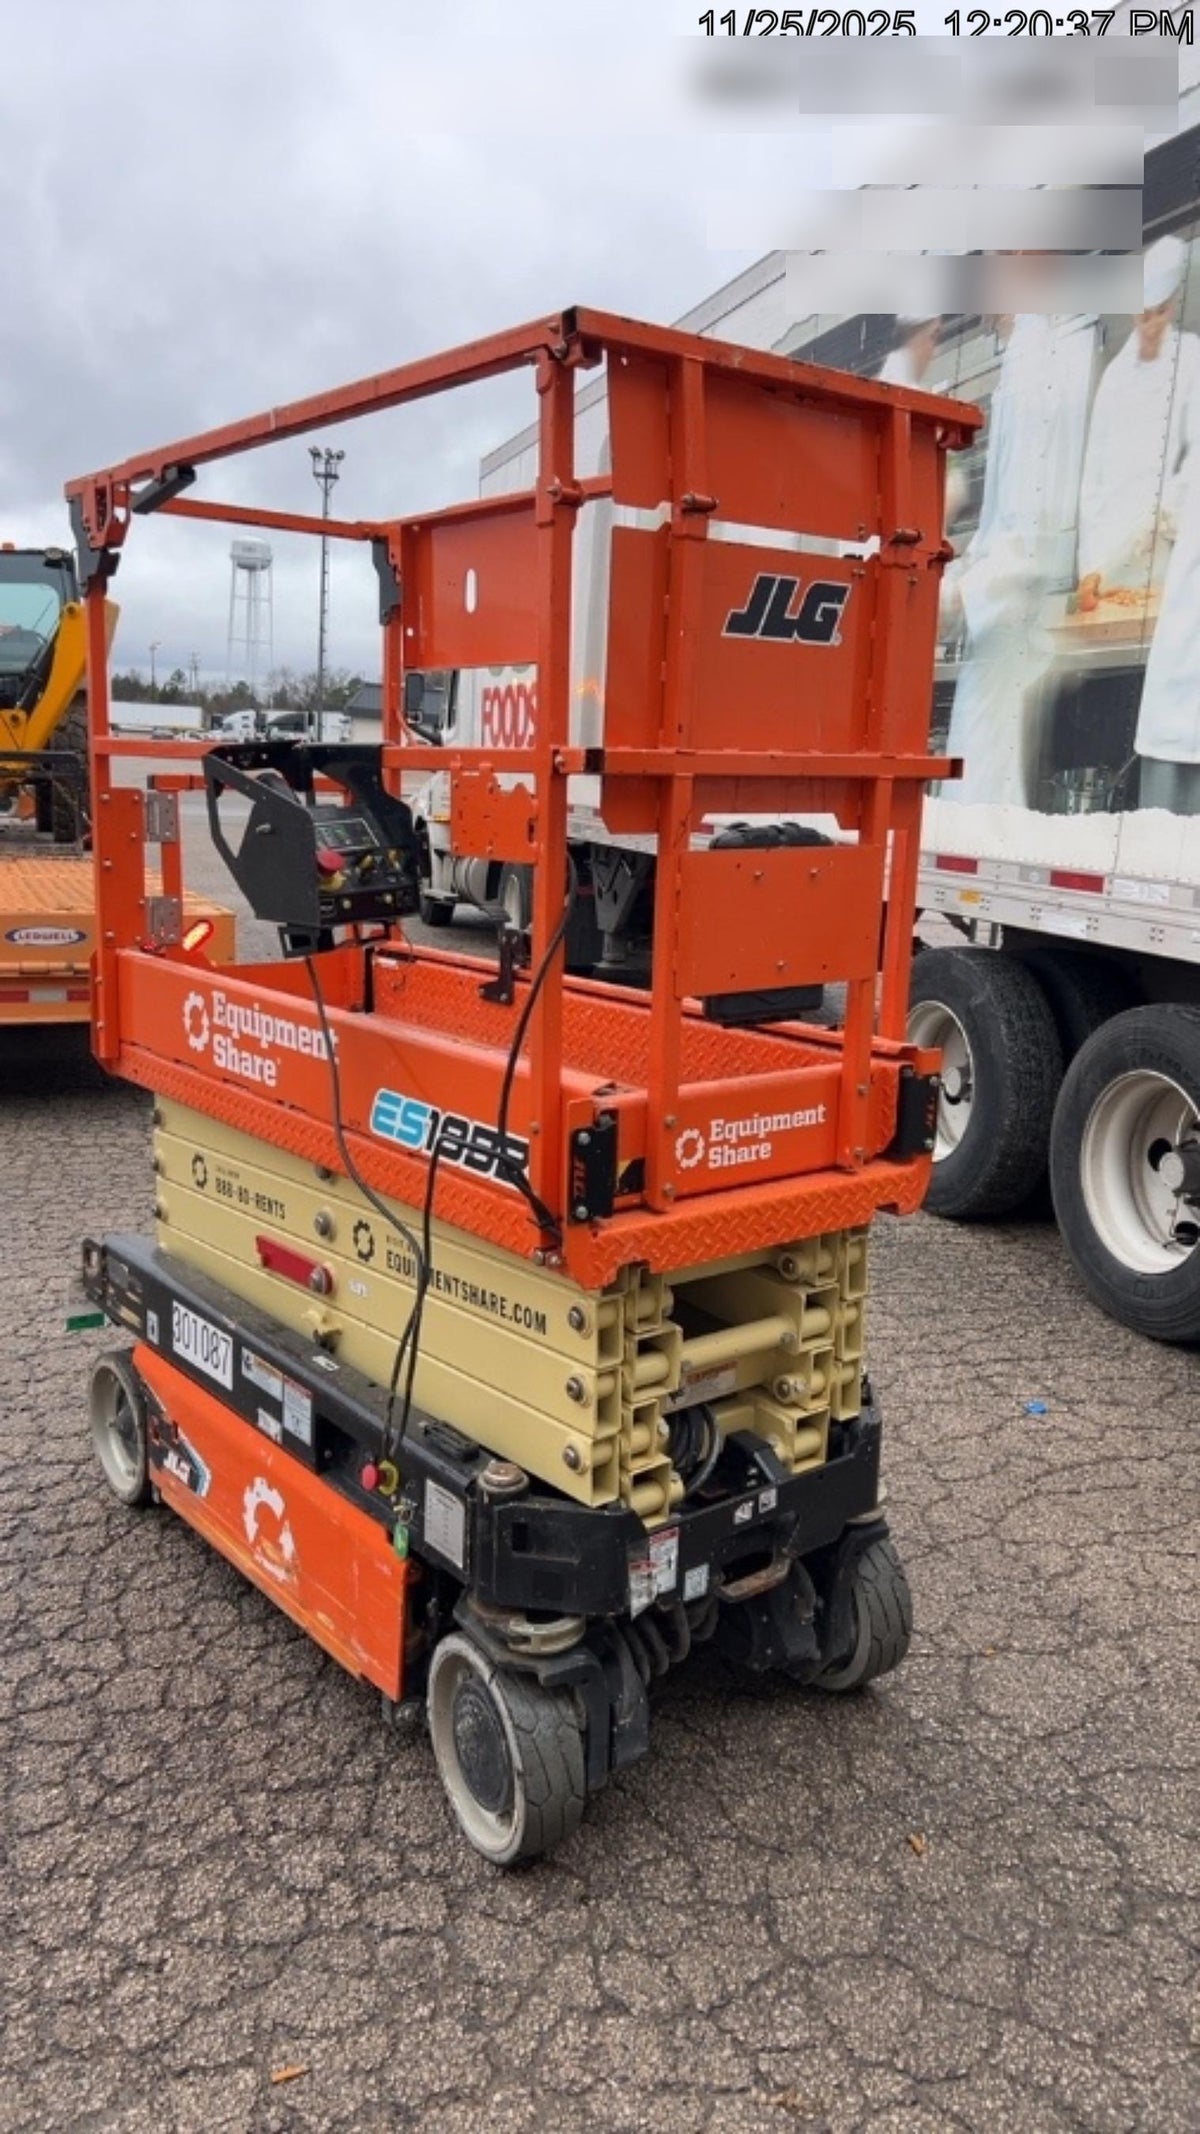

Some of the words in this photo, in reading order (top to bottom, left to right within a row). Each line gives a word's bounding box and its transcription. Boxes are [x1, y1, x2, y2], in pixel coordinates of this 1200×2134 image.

[721, 572, 852, 646] JLG
[212, 990, 340, 1065] Equipment
[213, 1033, 276, 1087] Share
[710, 1104, 826, 1143] Equipment
[708, 1142, 771, 1169] Share
[386, 1251, 547, 1335] EQUIENTSHARE.COM
[173, 1305, 231, 1375] 301087
[163, 1450, 191, 1484] JLG
